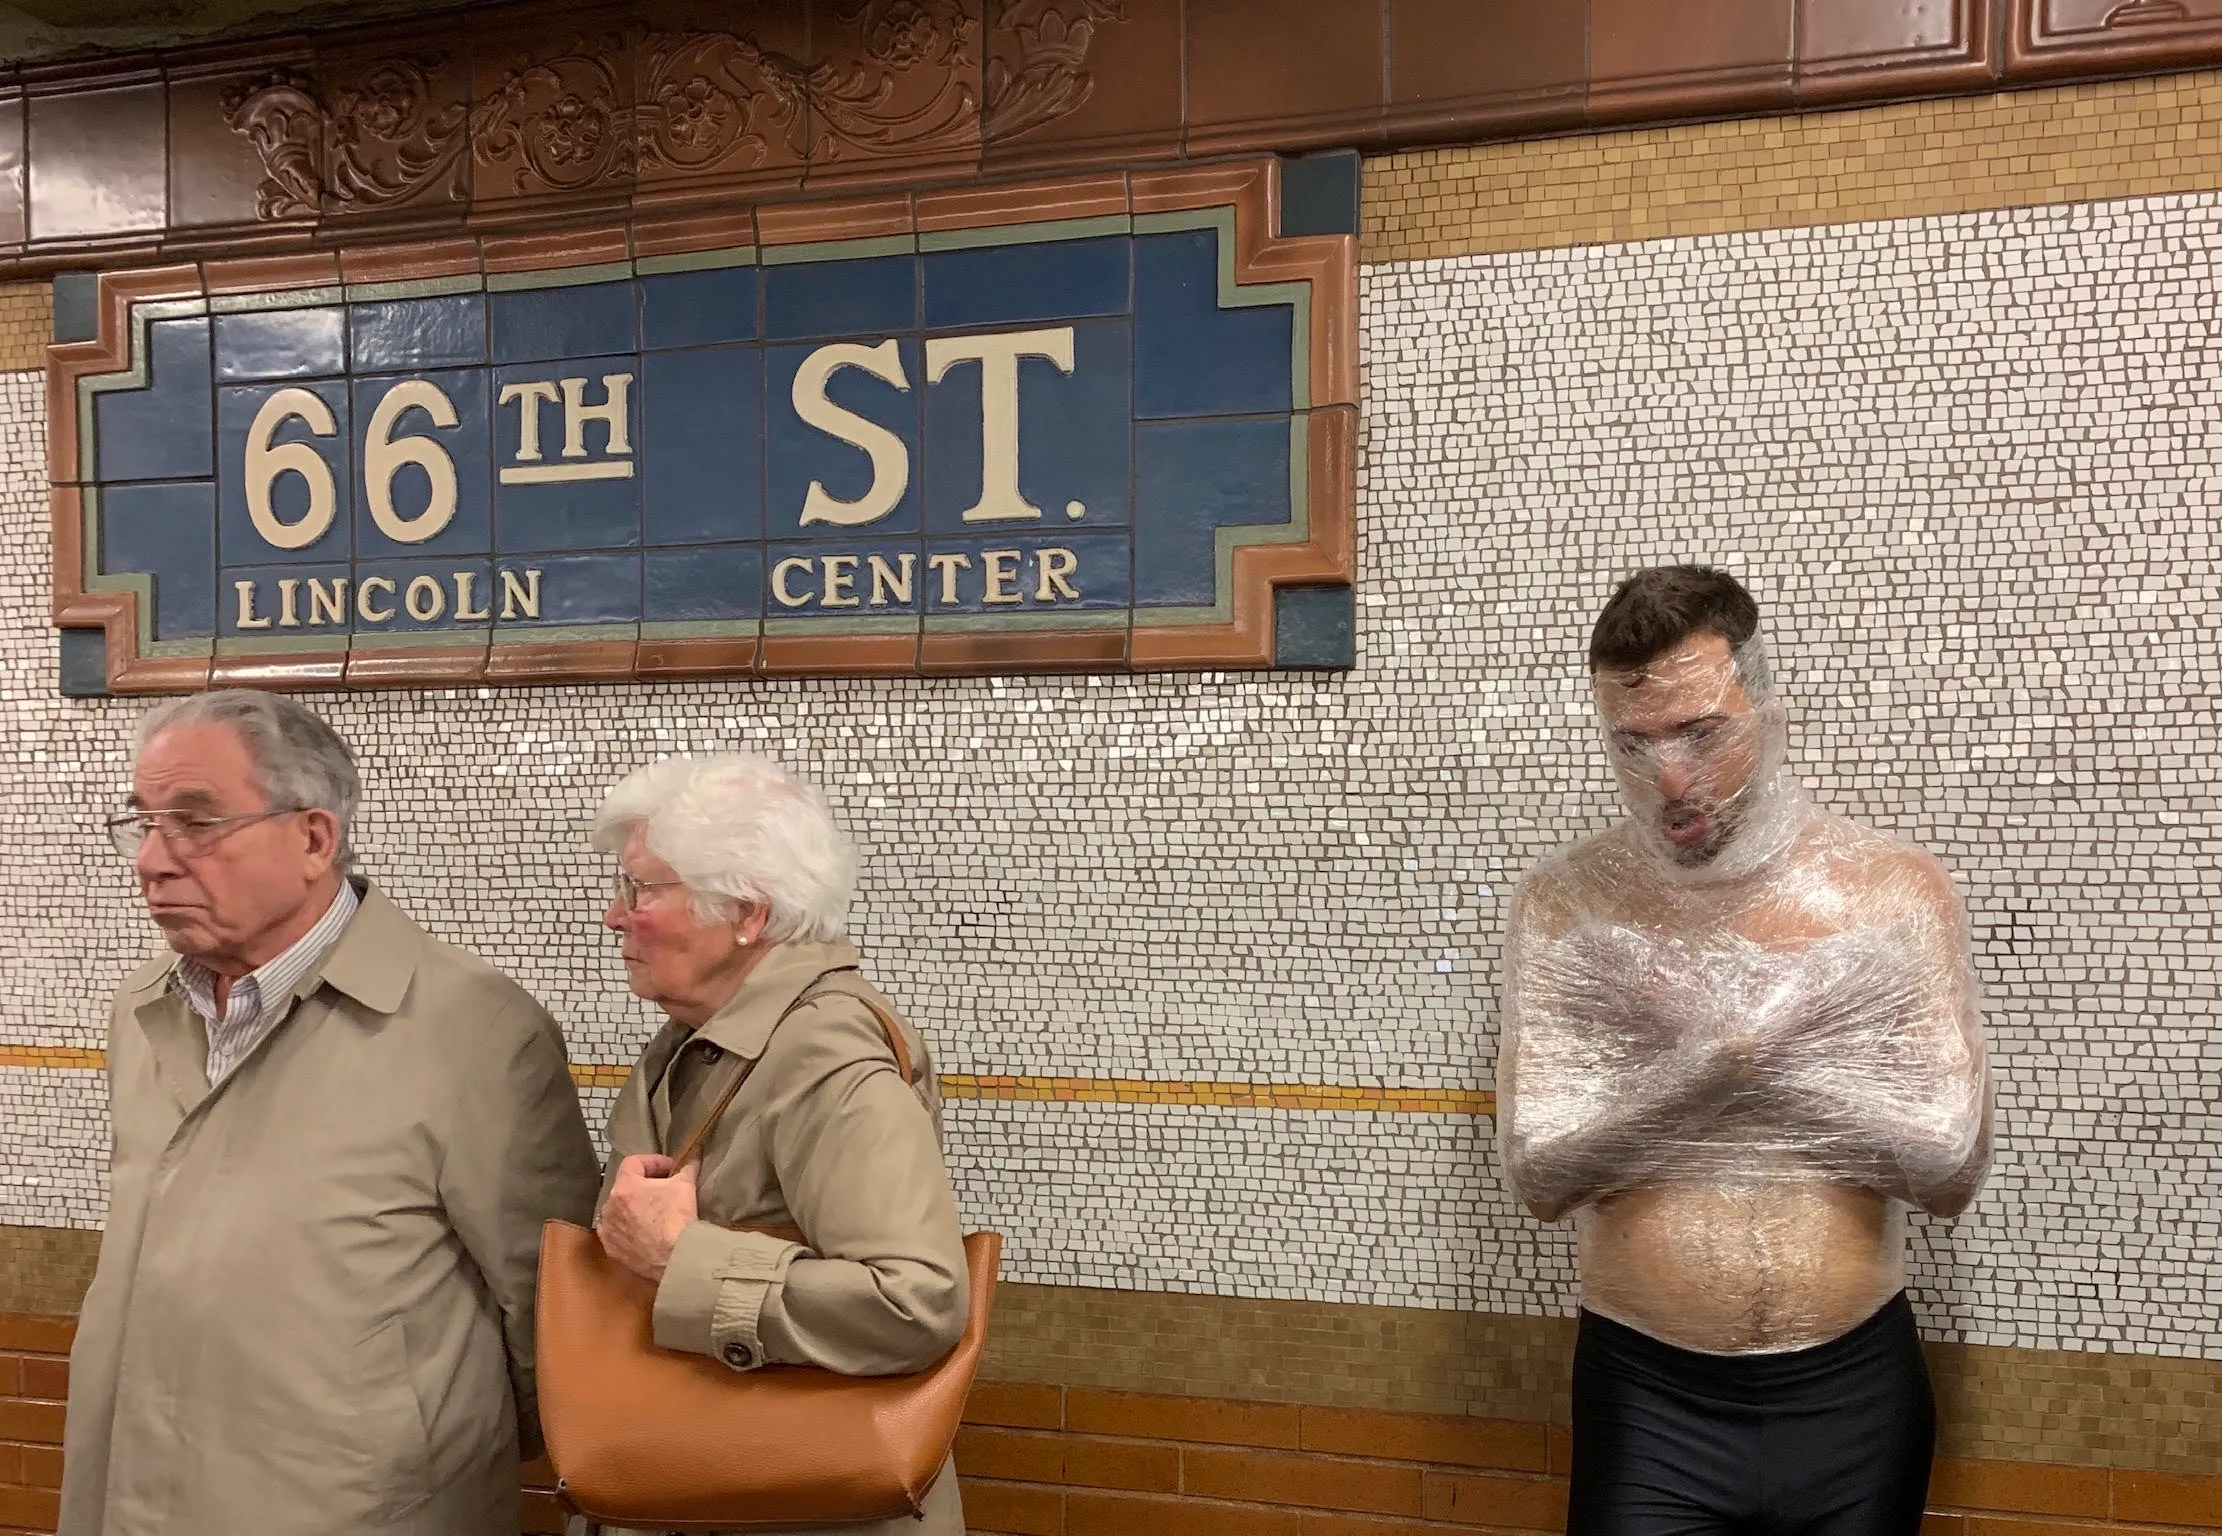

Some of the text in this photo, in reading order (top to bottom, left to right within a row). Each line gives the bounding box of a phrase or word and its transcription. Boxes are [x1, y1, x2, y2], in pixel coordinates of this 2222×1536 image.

[244, 326, 1086, 548] 66TH ST.
[235, 547, 1080, 629] LINCOLN CENTER
